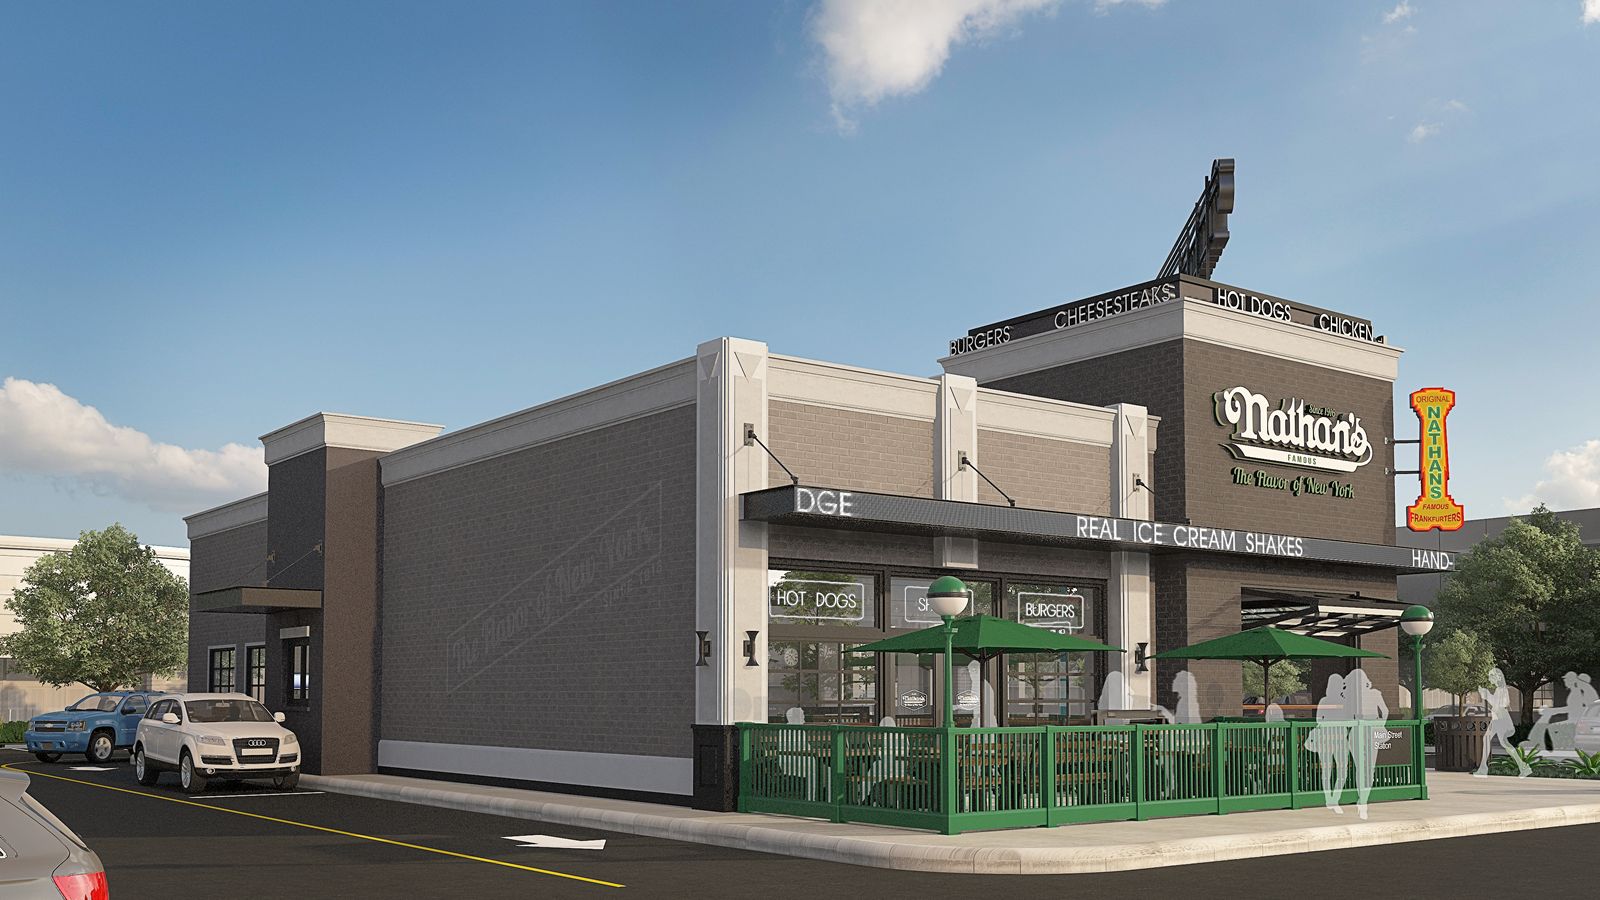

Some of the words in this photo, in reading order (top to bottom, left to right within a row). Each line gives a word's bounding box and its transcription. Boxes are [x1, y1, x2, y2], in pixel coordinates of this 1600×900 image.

[1054, 283, 1176, 329] CHEESESTEAKS
[1217, 287, 1245, 310] HOT
[1251, 296, 1291, 322] DOGS
[1319, 313, 1374, 342] CHICKEN
[950, 326, 1011, 356] BURGERS
[1308, 403, 1324, 416] Since
[1415, 395, 1450, 403] ORIGINAL
[1223, 386, 1368, 457] Nathan's
[1287, 454, 1317, 465] FAMOUS
[1427, 406, 1442, 499] NATHANS
[1232, 466, 1252, 484] The
[1256, 470, 1288, 490] Flavor
[1293, 475, 1303, 496] of
[1306, 477, 1328, 495] New
[1331, 480, 1355, 498] York
[796, 487, 852, 516] DGE
[1410, 512, 1462, 523] FRANKFURTERS
[1076, 516, 1121, 541] REAL
[1133, 521, 1163, 544] ICE
[1173, 526, 1236, 551] CREAM
[1245, 533, 1304, 557] SHAKES
[1412, 549, 1454, 570] HAND-
[777, 590, 807, 606] HOT
[816, 592, 857, 609] DOGS
[1025, 602, 1075, 618] BURGERS
[1374, 731, 1387, 739] Main
[1387, 730, 1403, 739] Street
[1374, 741, 1392, 750] Station
